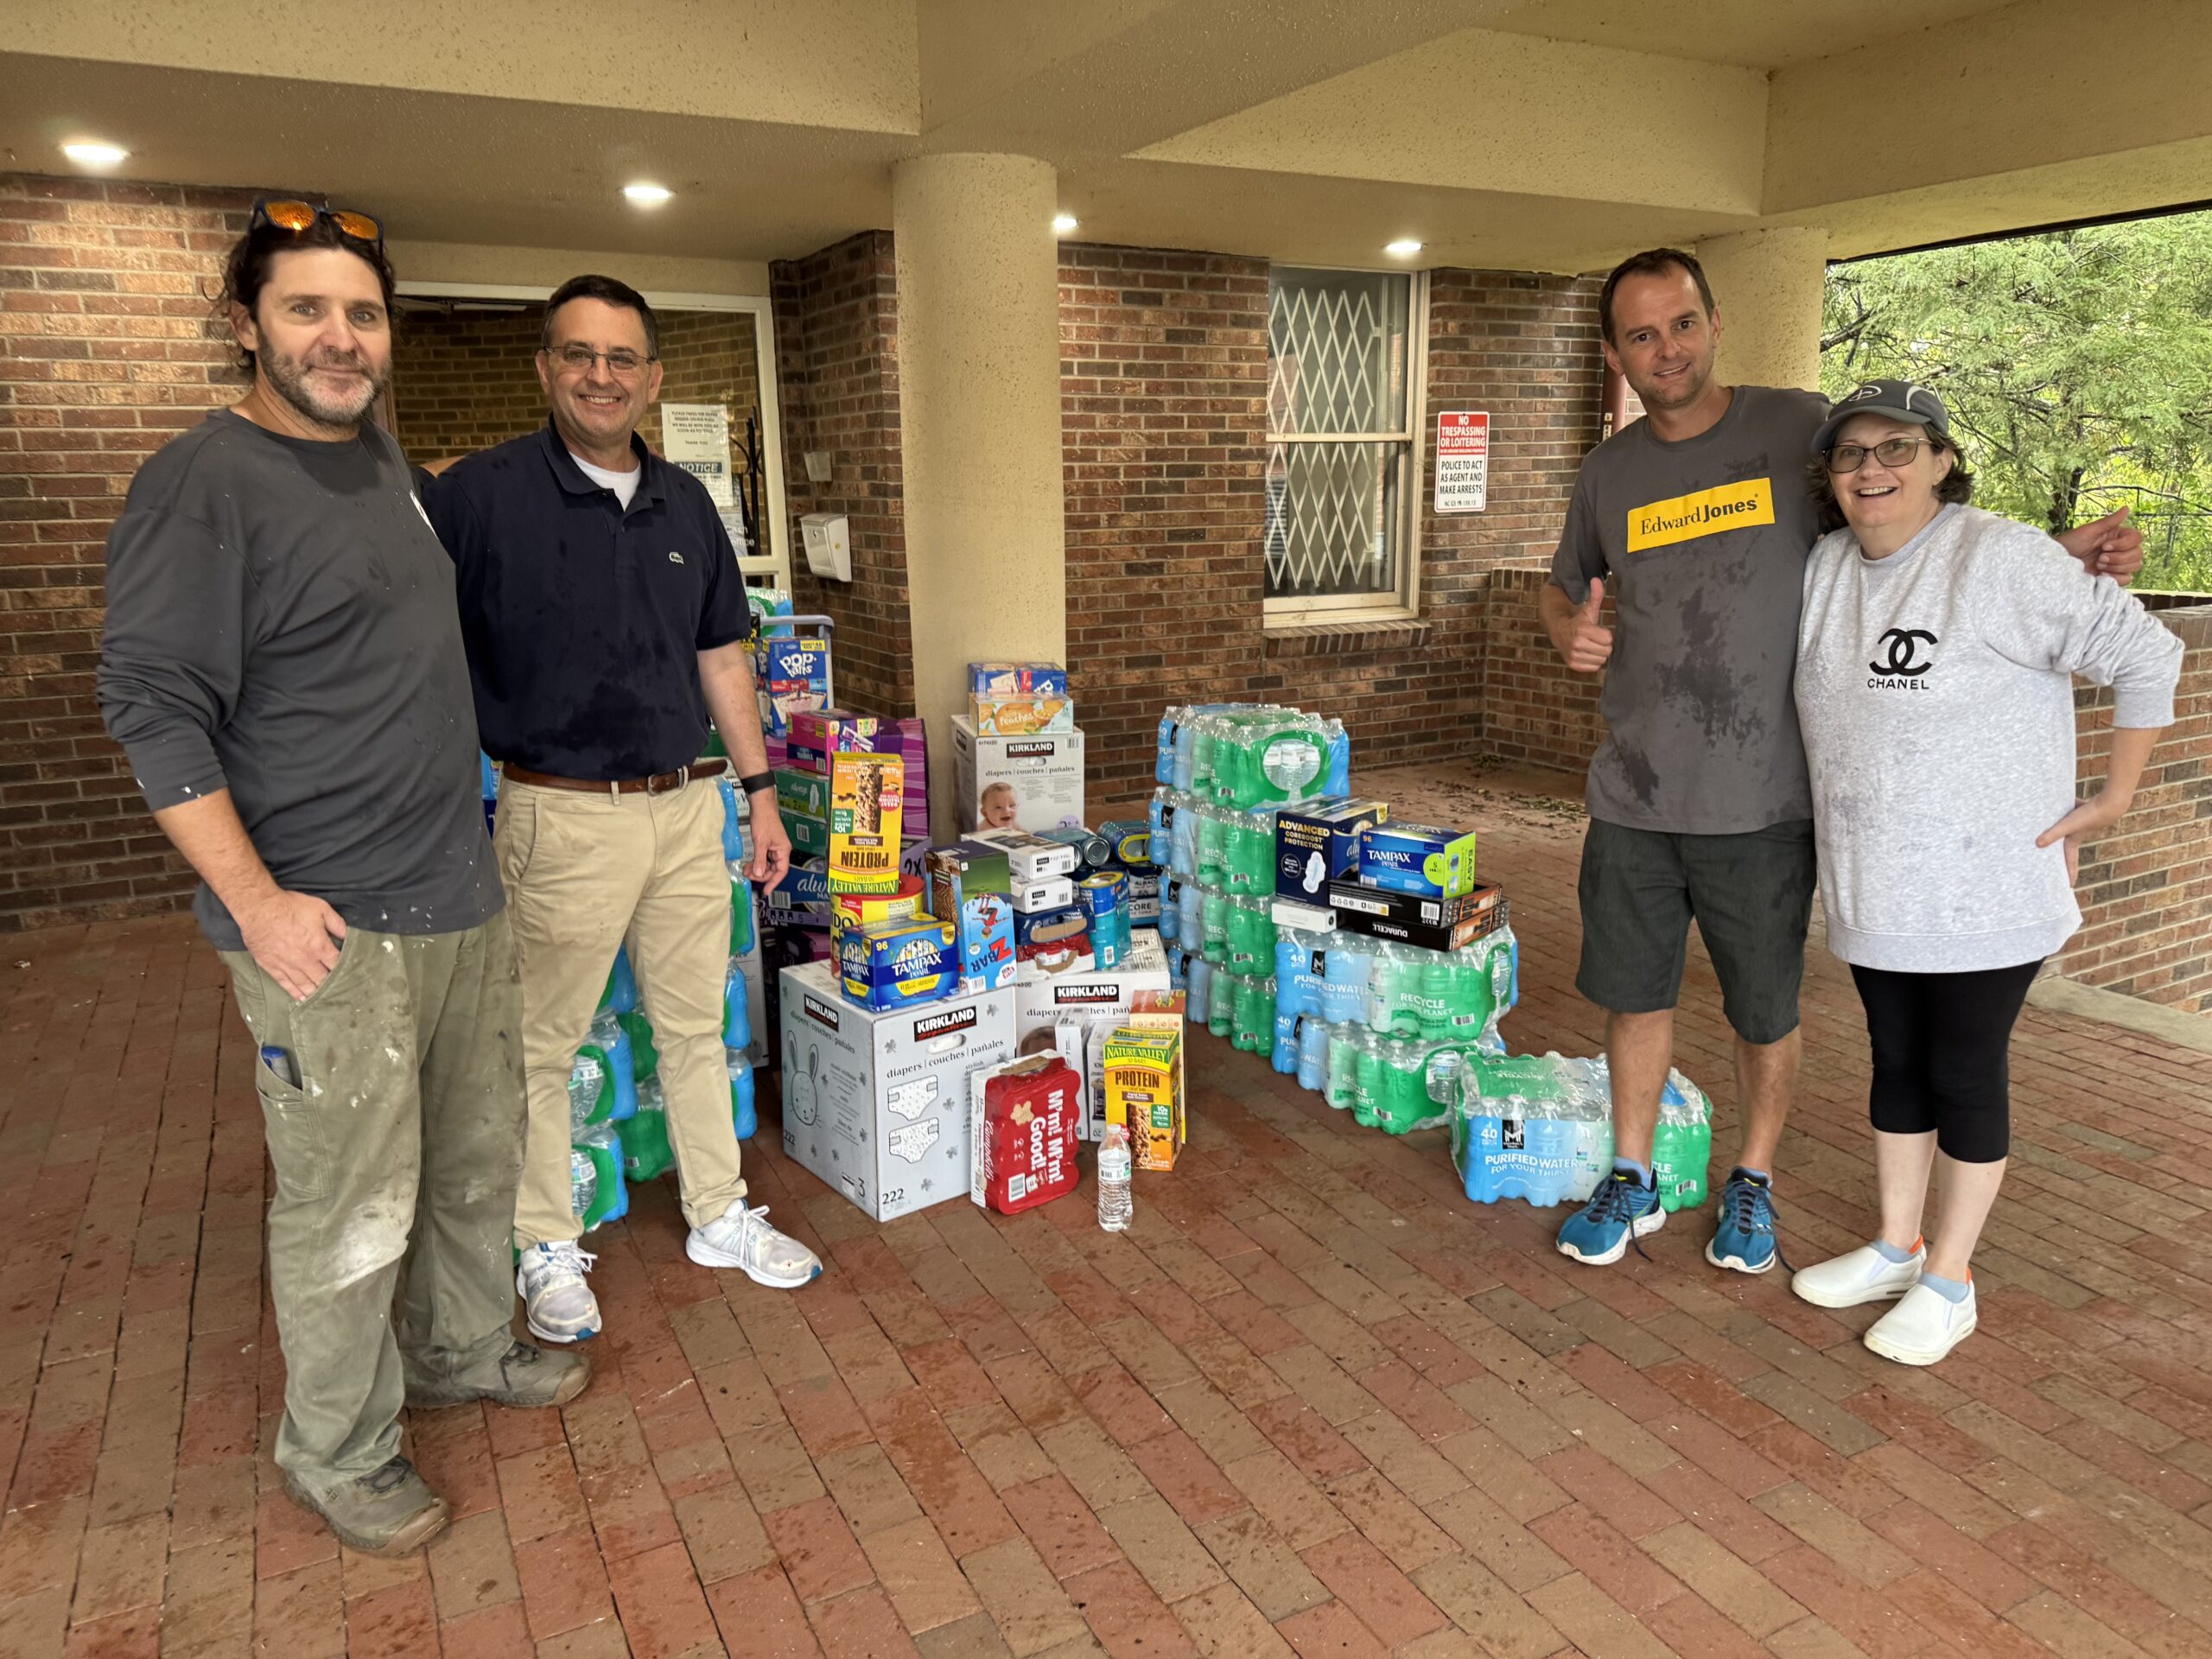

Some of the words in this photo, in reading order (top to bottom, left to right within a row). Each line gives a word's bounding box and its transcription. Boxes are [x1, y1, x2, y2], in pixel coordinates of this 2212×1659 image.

[1459, 416, 1469, 426] NO
[1441, 426, 1486, 437] TRESPASSING
[1440, 437, 1451, 448] OR
[1451, 437, 1486, 448] LOITERING
[678, 462, 718, 473] NOTICE
[1441, 461, 1462, 470] POLICE
[1462, 461, 1471, 470] TO
[1471, 461, 1483, 469] ACT
[1440, 473, 1448, 482] AS
[1449, 473, 1469, 482] AGENT
[1469, 473, 1483, 481] AND
[1440, 485, 1456, 494] MAKE
[1457, 485, 1483, 494] ARRESTS
[1640, 506, 1701, 536] Edward
[1703, 499, 1758, 523] Jones
[1867, 678, 1929, 690] CHANEL
[1008, 742, 1053, 753] KIRKLAND
[985, 769, 1013, 778] diapers
[1016, 767, 1045, 776] couches
[1049, 765, 1076, 775] pañales
[1279, 820, 1331, 836] ADVANCED
[1284, 837, 1324, 850] PROTECTION
[1285, 830, 1323, 843] COREBOOST
[842, 851, 889, 868] PROTEIN
[1367, 849, 1411, 863] TAMPAX
[797, 874, 830, 893] alw
[832, 879, 865, 893] VALLEY
[864, 880, 896, 893] NATURE
[1372, 923, 1408, 938] DURACELL
[875, 941, 888, 951] 96
[892, 952, 943, 976] TAMPAX
[1291, 954, 1306, 963] 40
[842, 961, 870, 976] TAMPAX
[1294, 975, 1335, 992] PURIFIED
[1058, 986, 1118, 998] KIRKLAND
[1401, 993, 1446, 1009] RECYCLE
[805, 996, 838, 1024] KIRKLAND
[1027, 1007, 1061, 1018] diapers
[791, 1009, 809, 1027] diapers
[810, 1022, 832, 1041] couches
[917, 1008, 975, 1034] KIRKLAND
[887, 1063, 922, 1079] diapers
[928, 1051, 965, 1068] couches
[970, 1039, 1004, 1058] pañales
[1106, 1046, 1138, 1058] NATURE
[1137, 1047, 1167, 1064] VALLEY
[1115, 1071, 1160, 1090] PROTEIN
[784, 1128, 795, 1147] 222
[1481, 1128, 1497, 1139] 40
[1030, 1116, 1047, 1171] Good!
[1485, 1153, 1538, 1166] PURIFIED
[1539, 1158, 1579, 1169] WATER
[1491, 1165, 1508, 1174] FOR
[1510, 1163, 1536, 1175] YOUR
[858, 1177, 866, 1198] 3
[881, 1188, 905, 1205] 222
